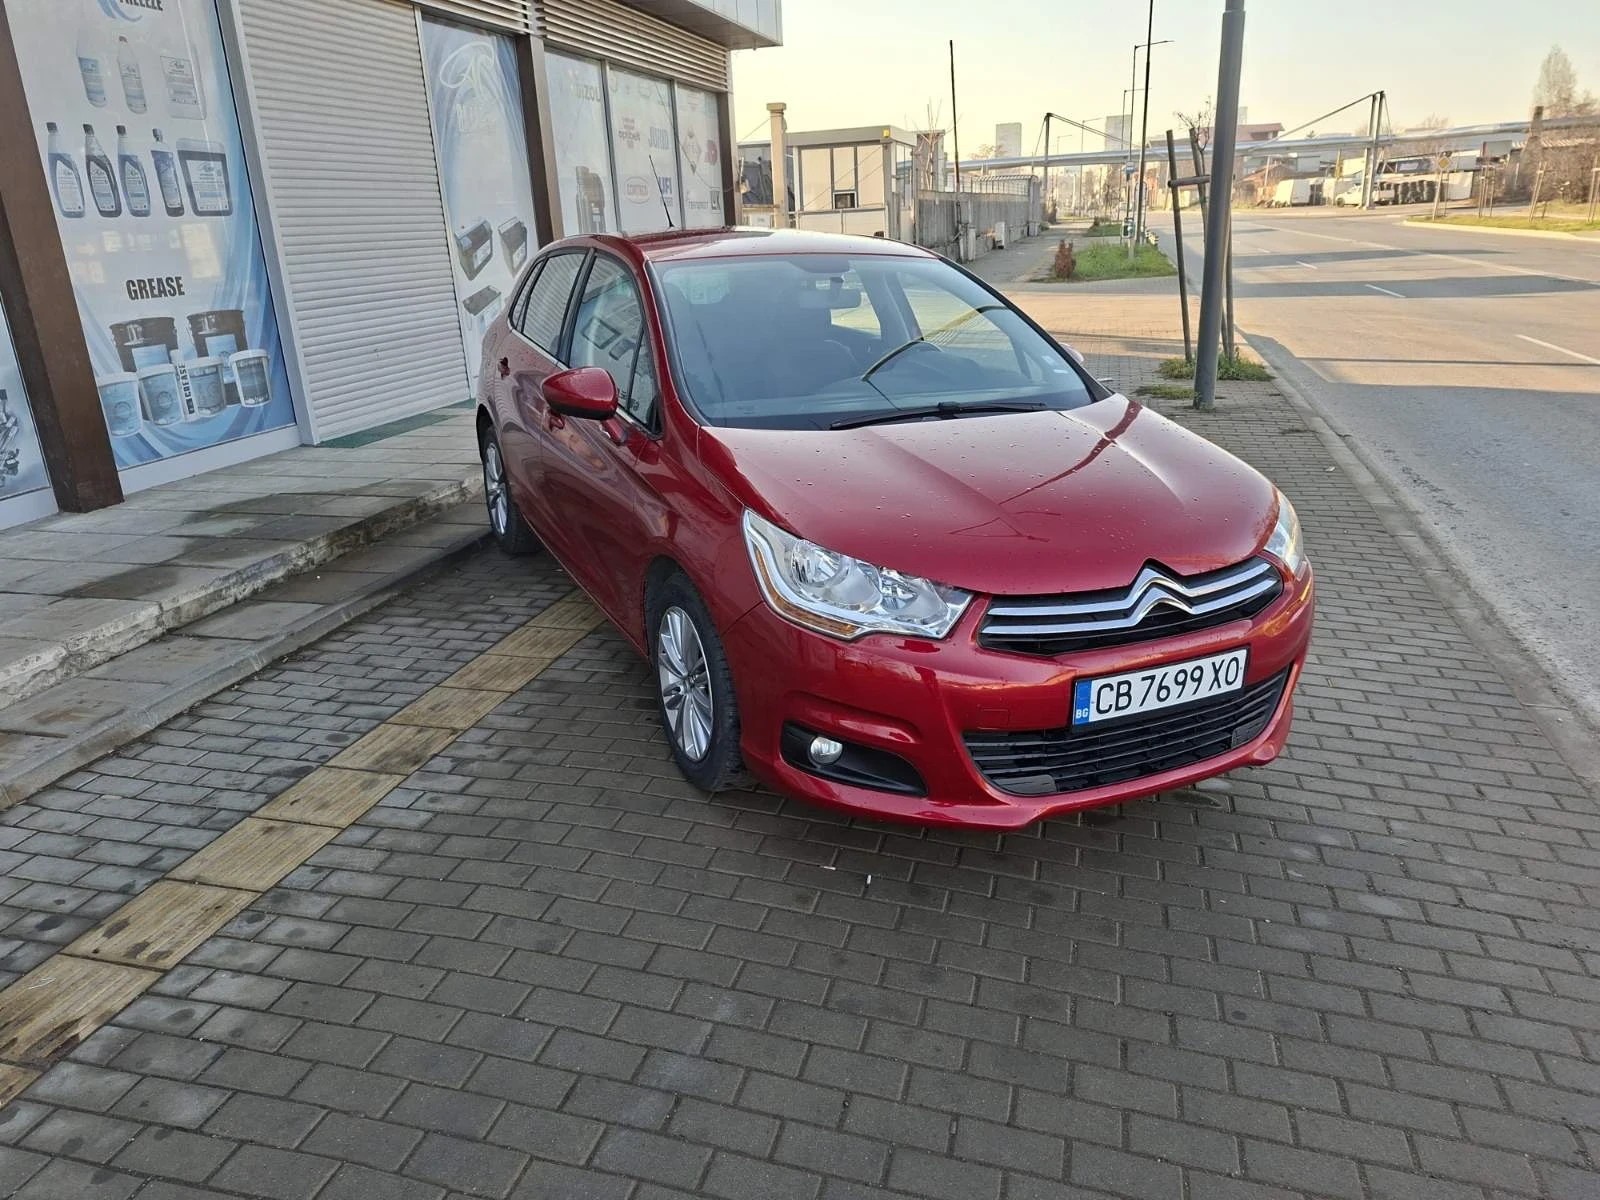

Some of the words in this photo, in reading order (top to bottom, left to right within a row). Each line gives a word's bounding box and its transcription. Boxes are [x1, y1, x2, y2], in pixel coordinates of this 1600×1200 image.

[126, 276, 185, 301] GREASE
[1095, 680, 1132, 715] CB
[1139, 665, 1204, 707] 7699
[1208, 656, 1240, 692] XO
[1076, 707, 1089, 719] BG
